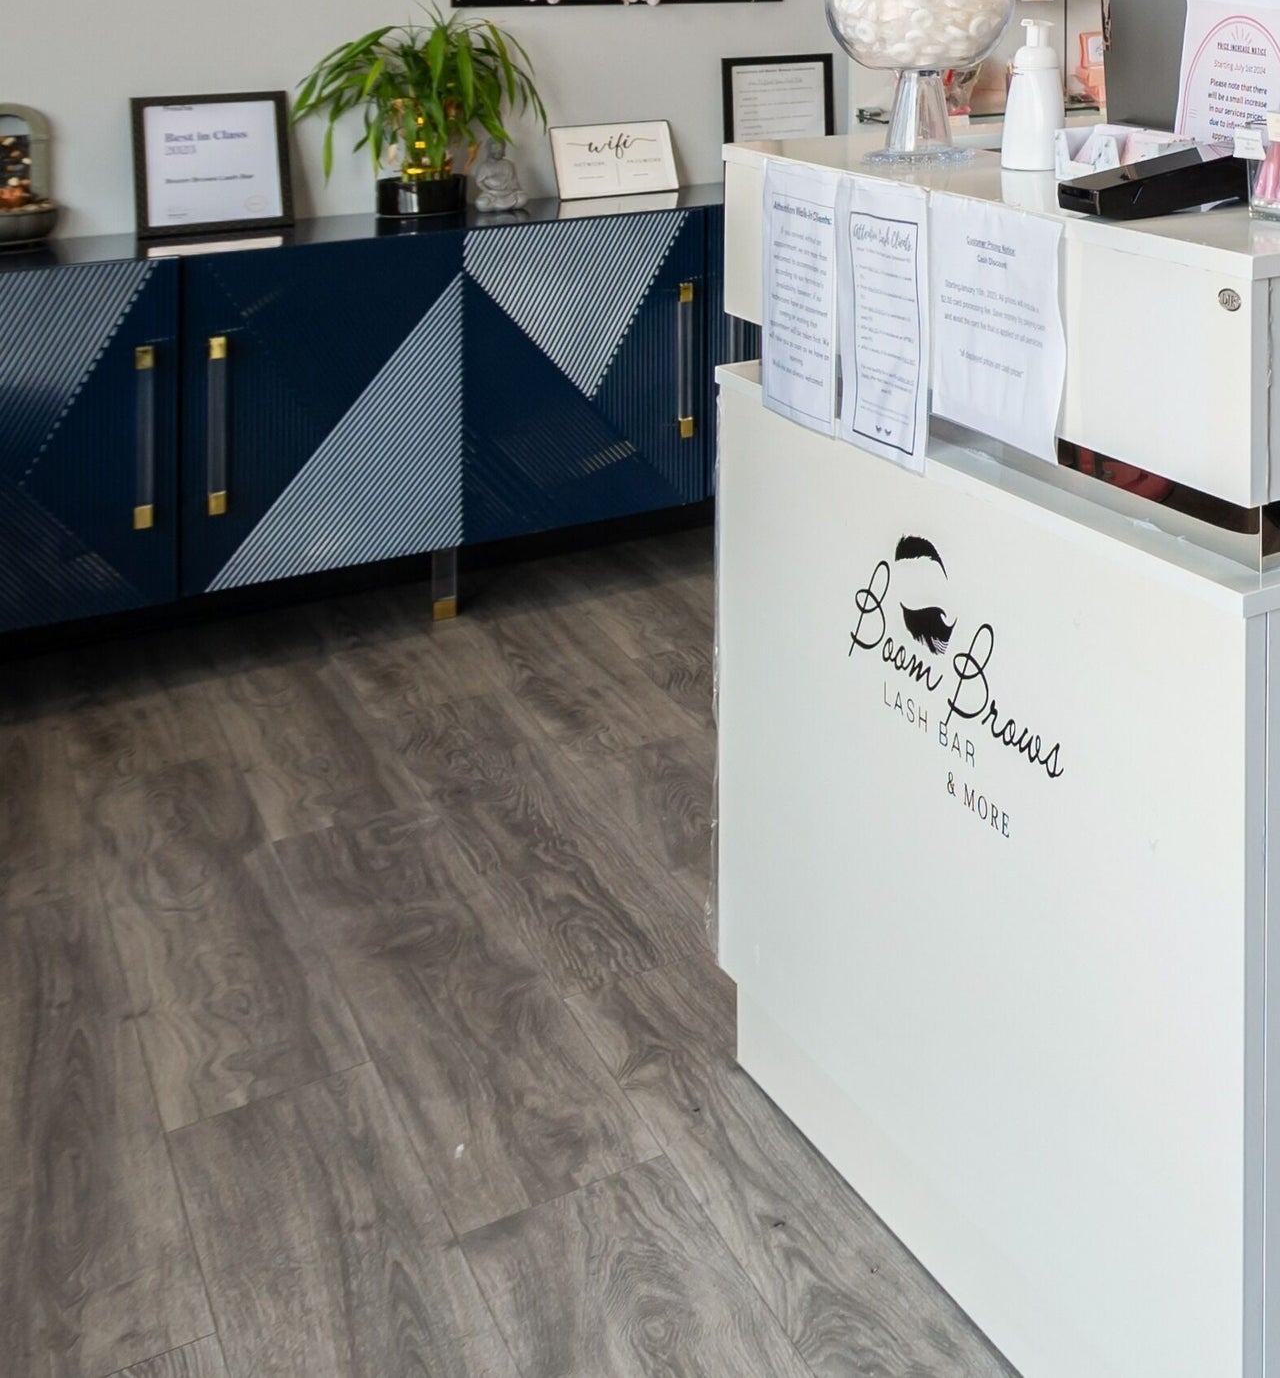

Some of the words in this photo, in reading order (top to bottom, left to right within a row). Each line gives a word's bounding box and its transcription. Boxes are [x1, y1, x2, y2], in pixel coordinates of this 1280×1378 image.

[1210, 78, 1227, 88] Please
[1228, 82, 1240, 90] note
[1241, 83, 1252, 92] that
[1253, 86, 1267, 95] there
[1208, 92, 1217, 100] will
[1230, 96, 1243, 104] small
[1245, 98, 1267, 108] increase
[1224, 107, 1245, 118] services
[1209, 118, 1219, 126] due
[1220, 119, 1225, 127] to
[165, 133, 194, 142] Best
[197, 132, 210, 141] in
[213, 130, 248, 140] Class
[848, 560, 944, 691] Boom
[944, 623, 1064, 779] Brows
[884, 681, 928, 733] LASH
[939, 720, 976, 768] BAR
[947, 771, 956, 797] &
[964, 783, 1010, 838] MORE
